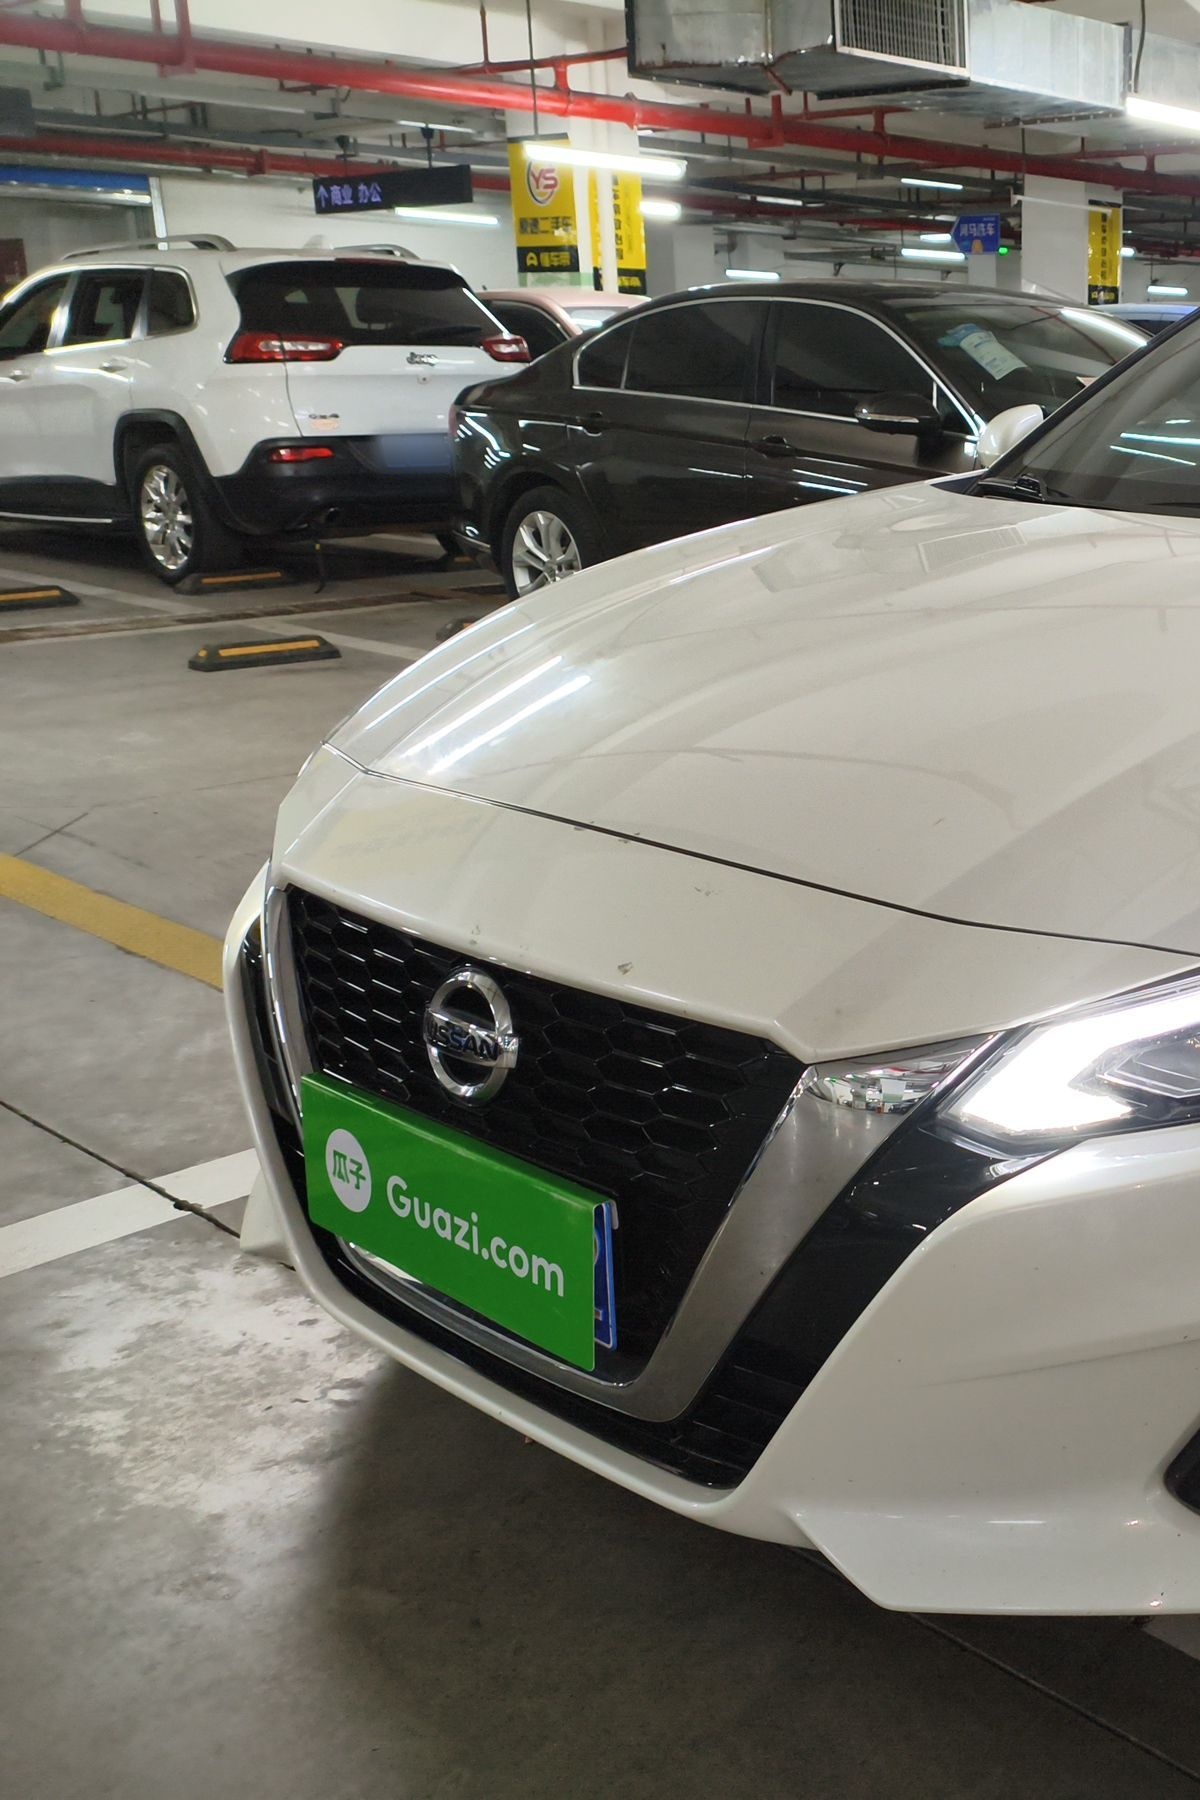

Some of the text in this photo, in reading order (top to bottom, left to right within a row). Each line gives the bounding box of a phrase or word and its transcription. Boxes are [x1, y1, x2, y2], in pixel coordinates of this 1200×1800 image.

[330, 181, 382, 206] 商业 办公
[530, 167, 559, 190] YS
[333, 1149, 367, 1190] 瓜子
[386, 1175, 564, 1297] Guazi.com
